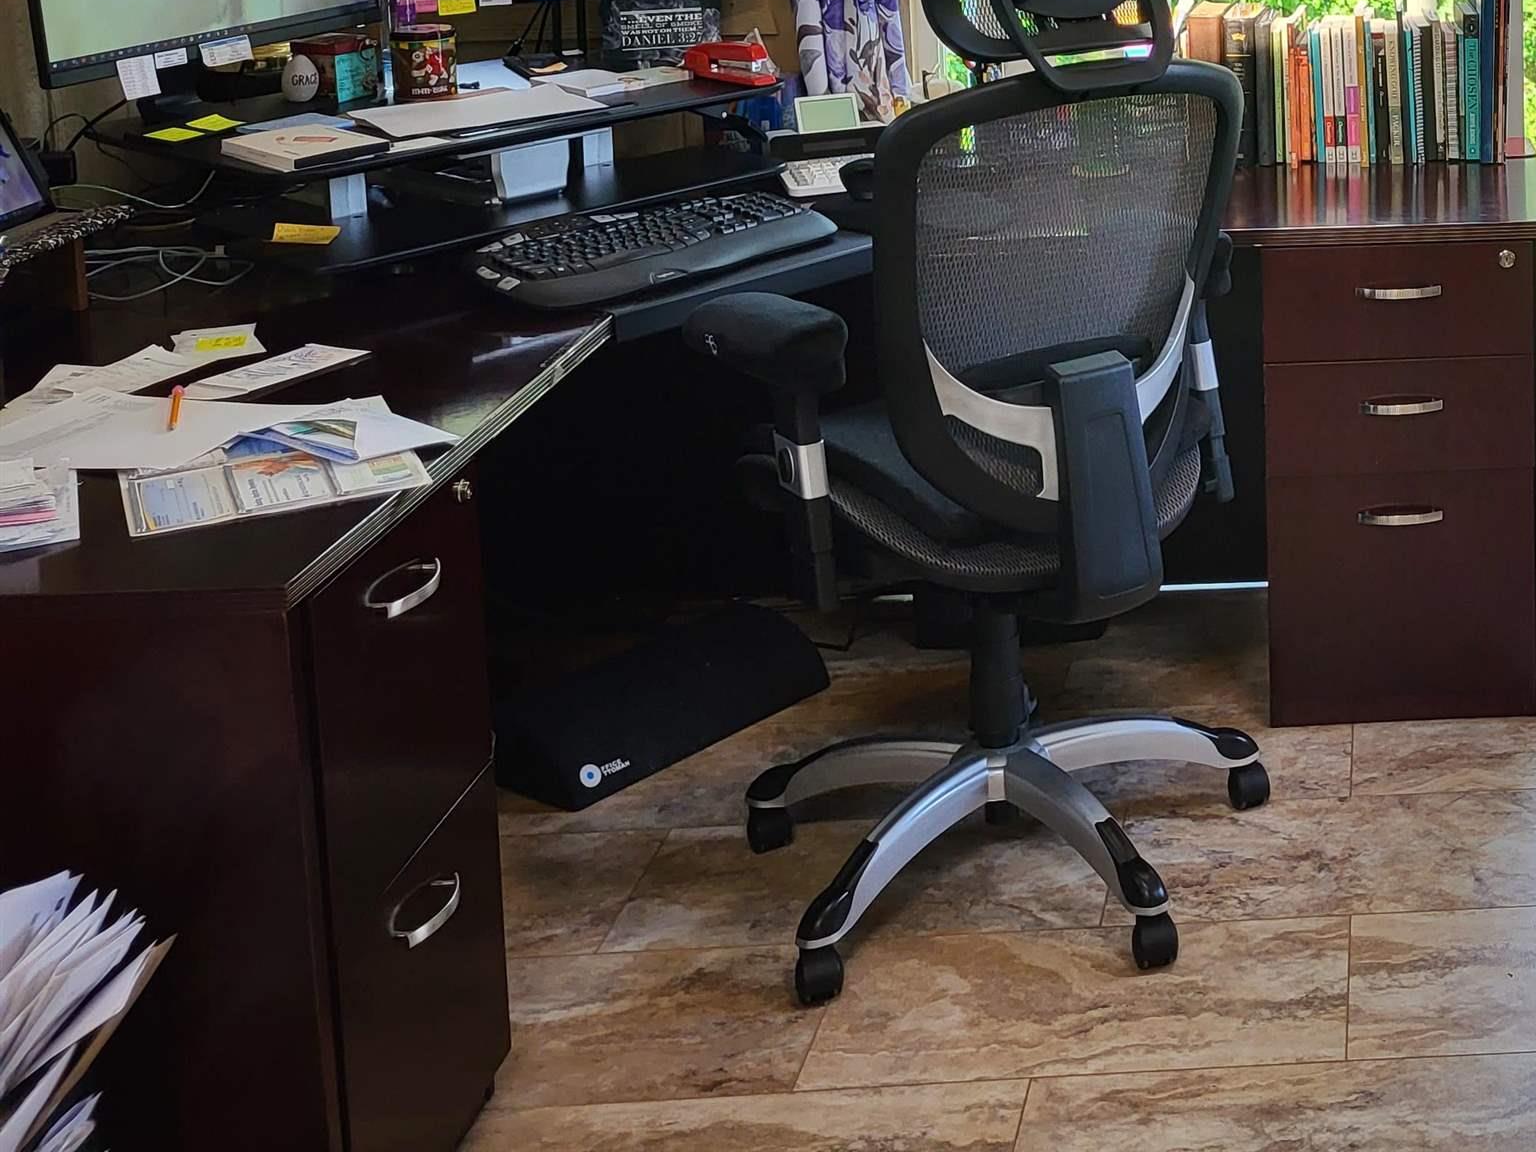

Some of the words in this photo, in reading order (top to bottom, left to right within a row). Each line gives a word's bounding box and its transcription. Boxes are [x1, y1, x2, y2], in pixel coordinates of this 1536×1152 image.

[675, 12, 702, 21] THE
[621, 23, 653, 31] SMELL
[622, 34, 675, 47] DANIEL
[678, 32, 703, 44] 3:27
[291, 72, 318, 86] GRACE
